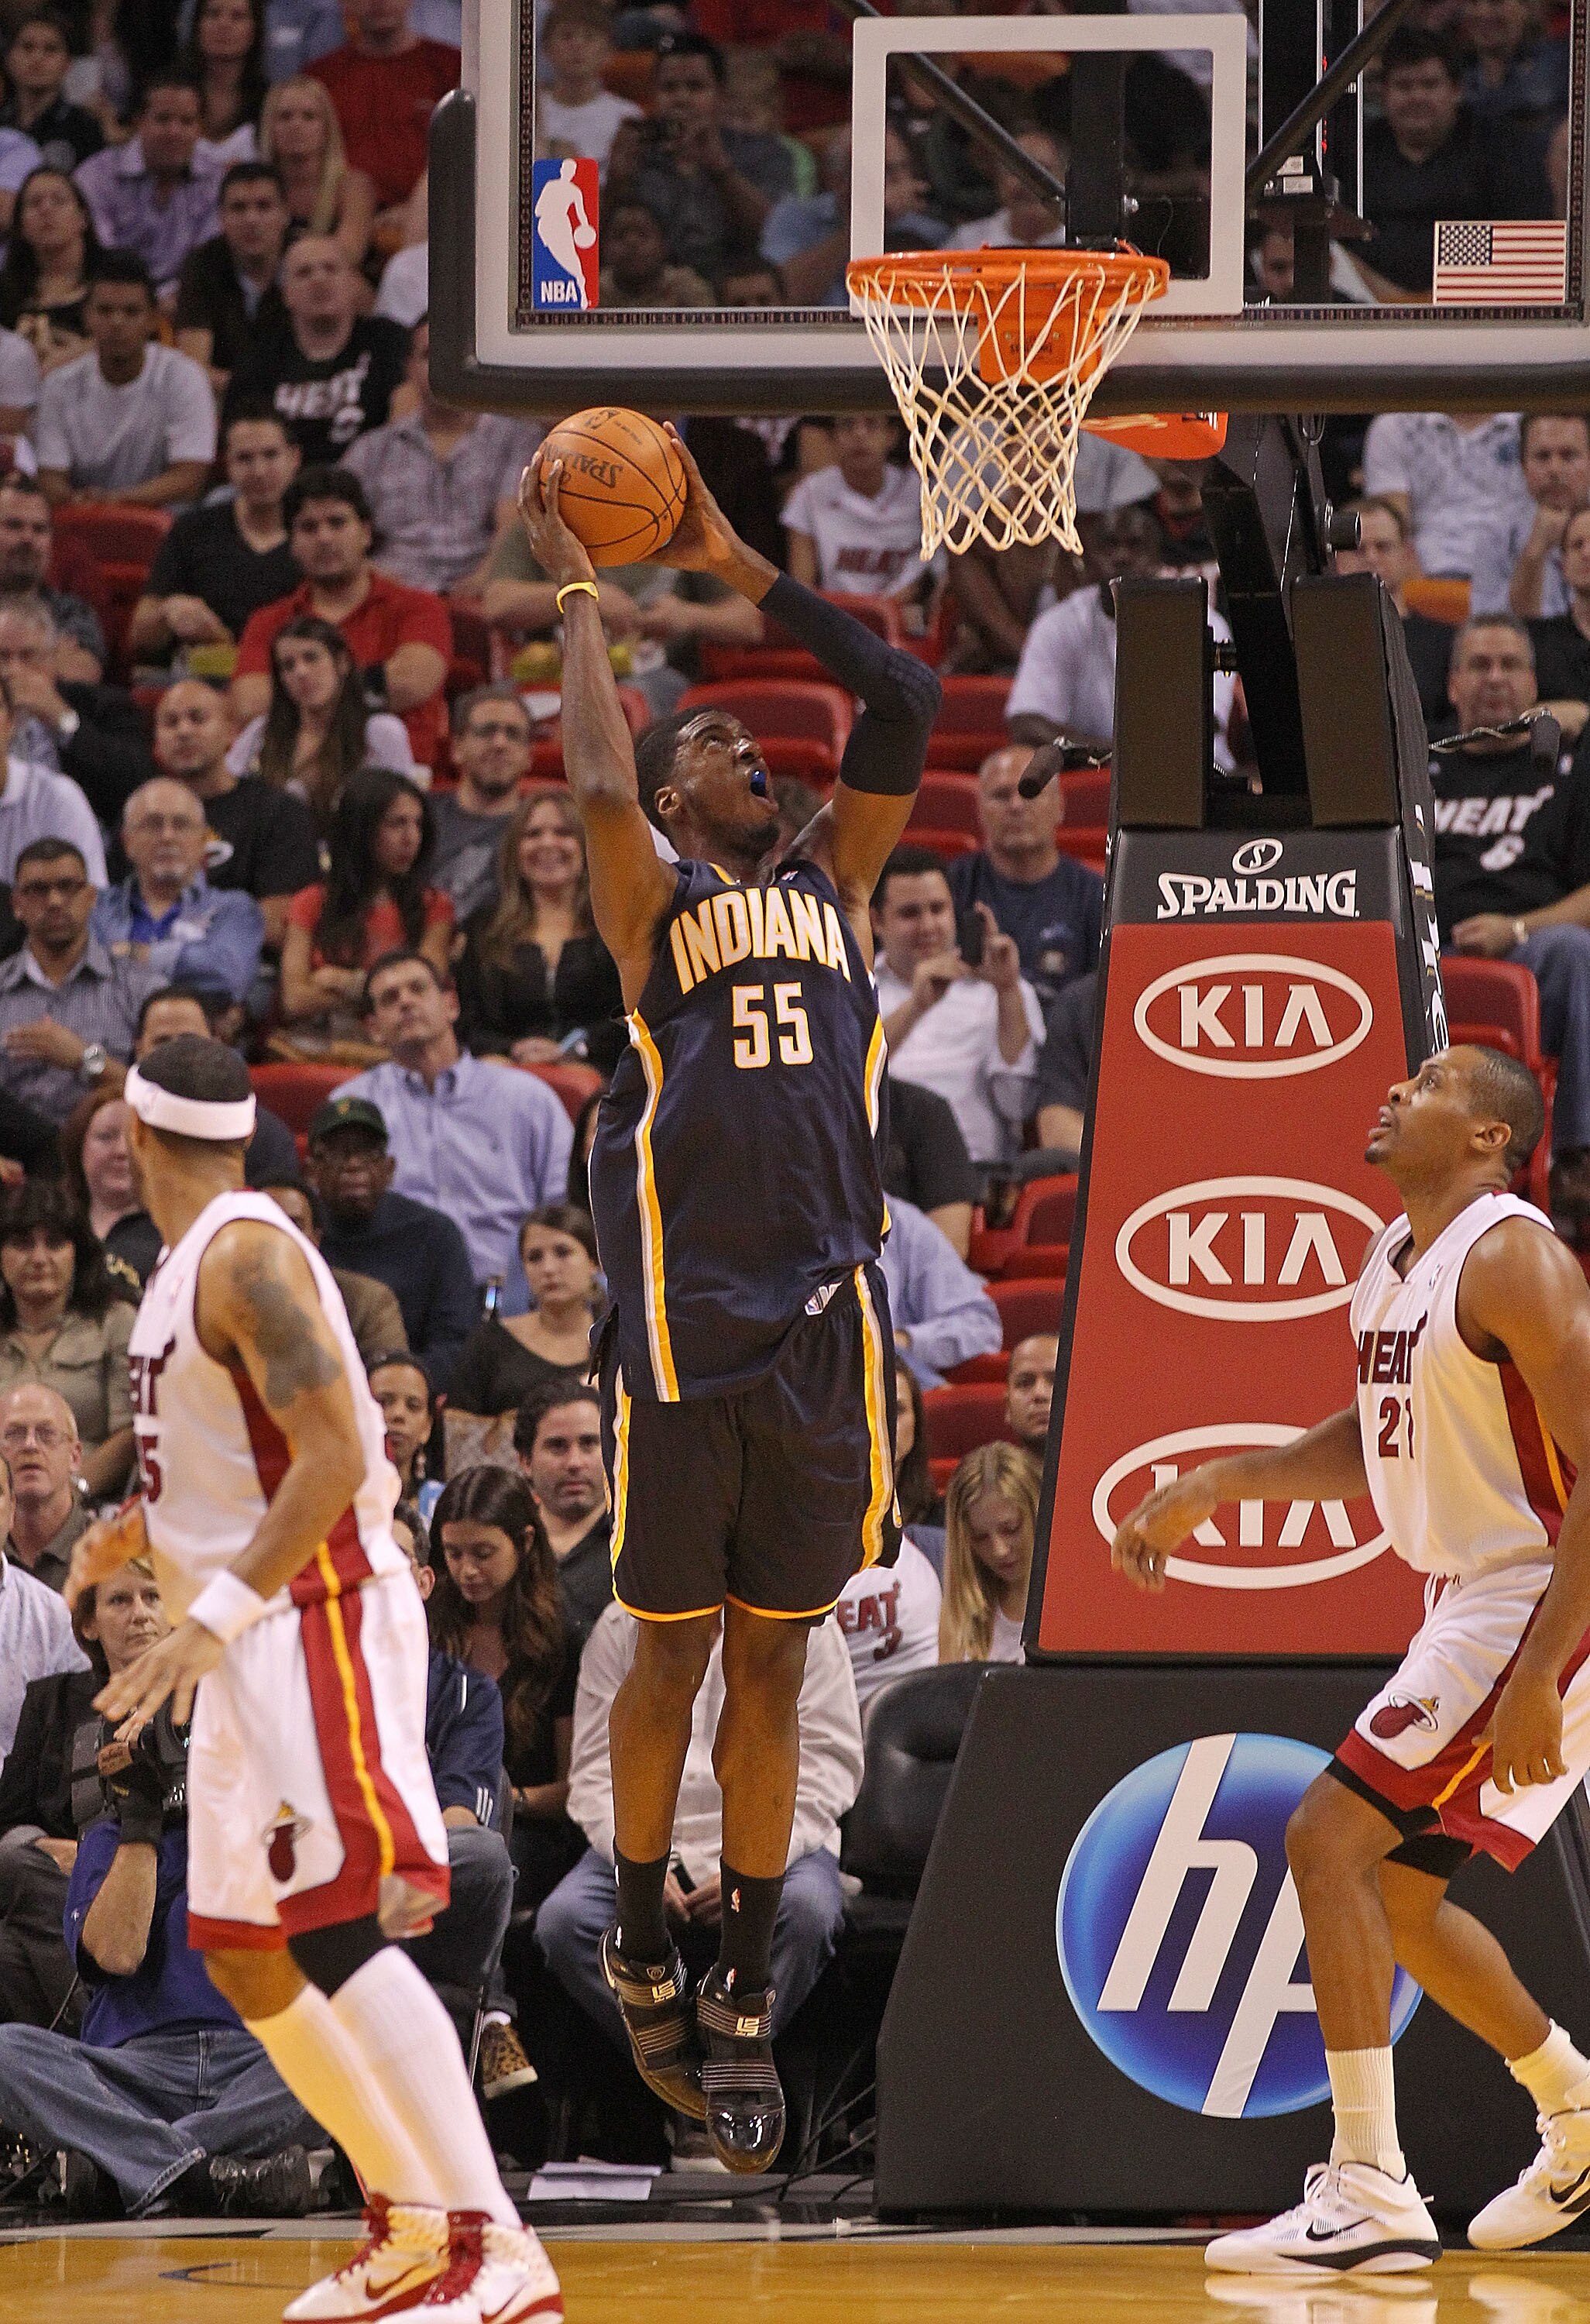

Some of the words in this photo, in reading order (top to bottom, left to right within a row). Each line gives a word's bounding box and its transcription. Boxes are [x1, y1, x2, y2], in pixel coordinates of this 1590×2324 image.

[541, 281, 579, 303] NBA
[1157, 869, 1357, 920] SPALDING
[670, 887, 852, 995] INDIANA
[732, 982, 814, 1070] 55
[1177, 984, 1334, 1047] KIA
[1166, 1212, 1348, 1285] KIA
[1358, 1309, 1428, 1384] HEAT
